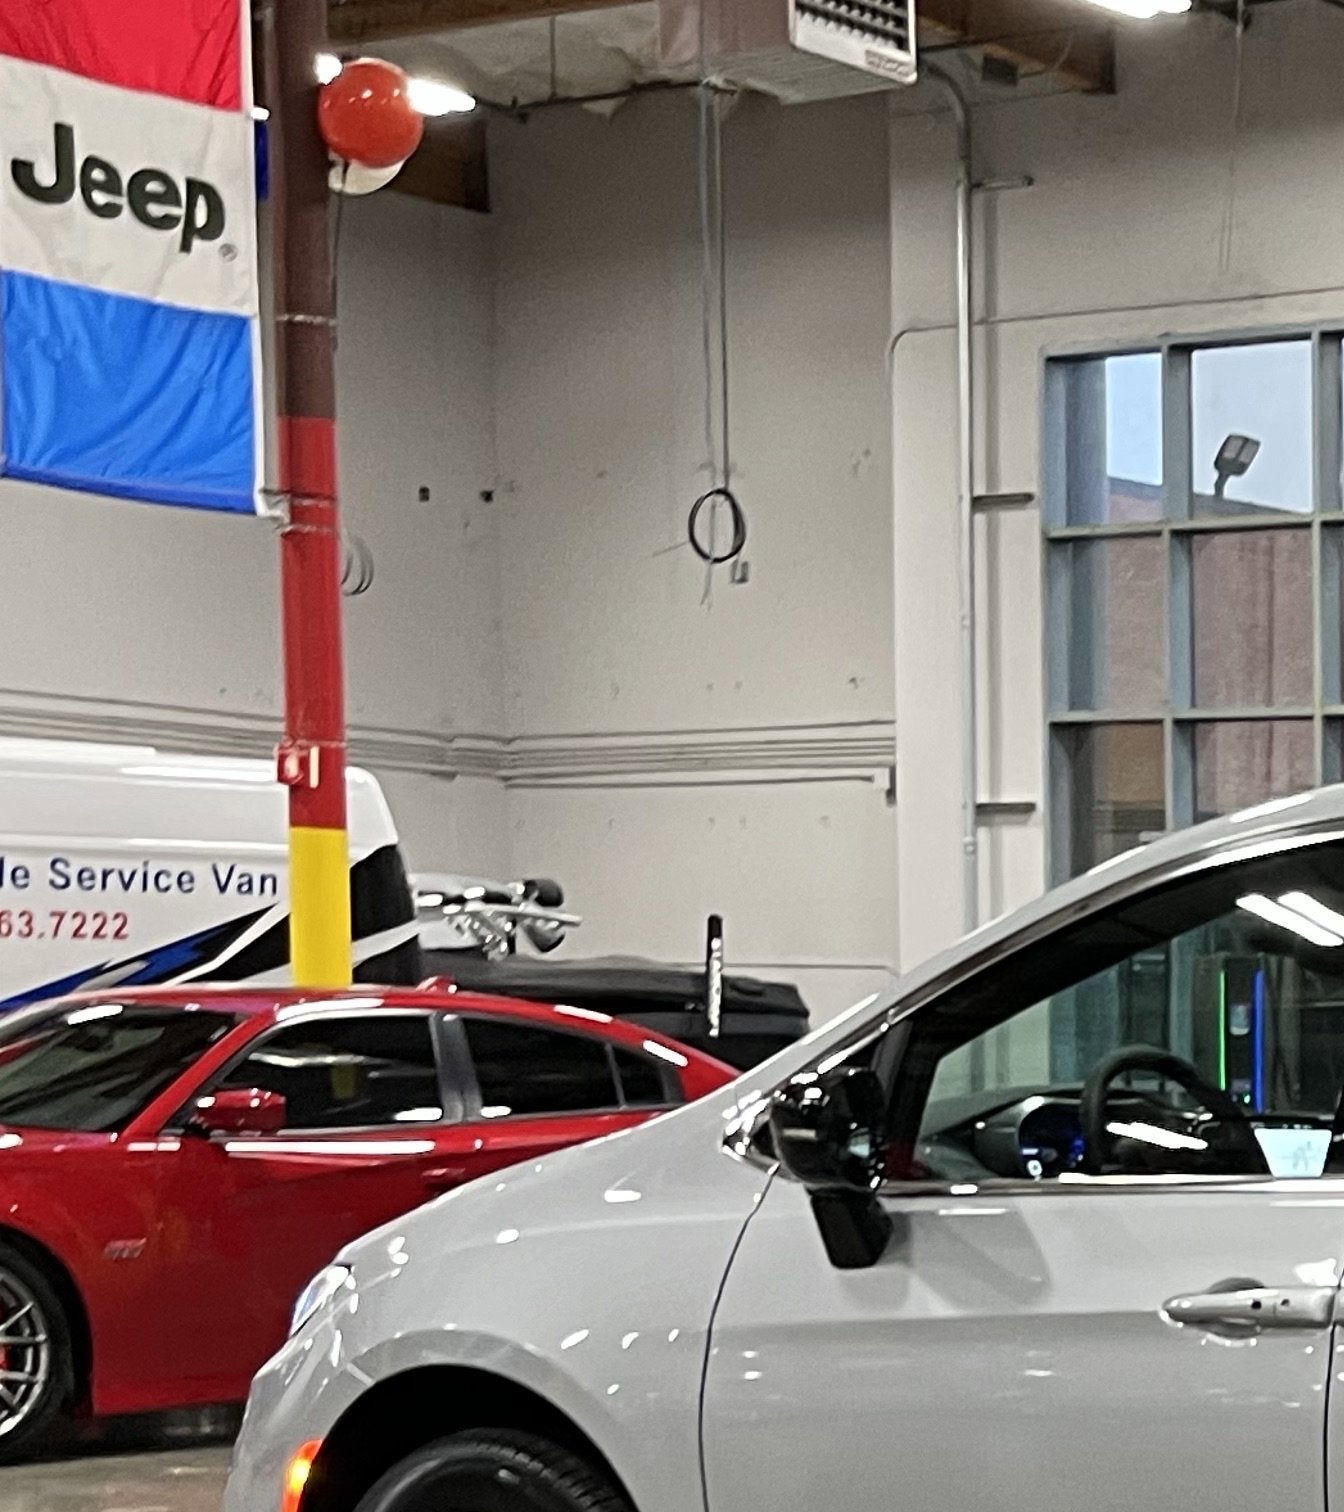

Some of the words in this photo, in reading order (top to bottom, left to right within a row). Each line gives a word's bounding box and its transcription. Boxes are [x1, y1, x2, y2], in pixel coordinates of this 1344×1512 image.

[10, 121, 226, 254] Jeep
[49, 857, 196, 894] Service
[212, 863, 278, 897] Van
